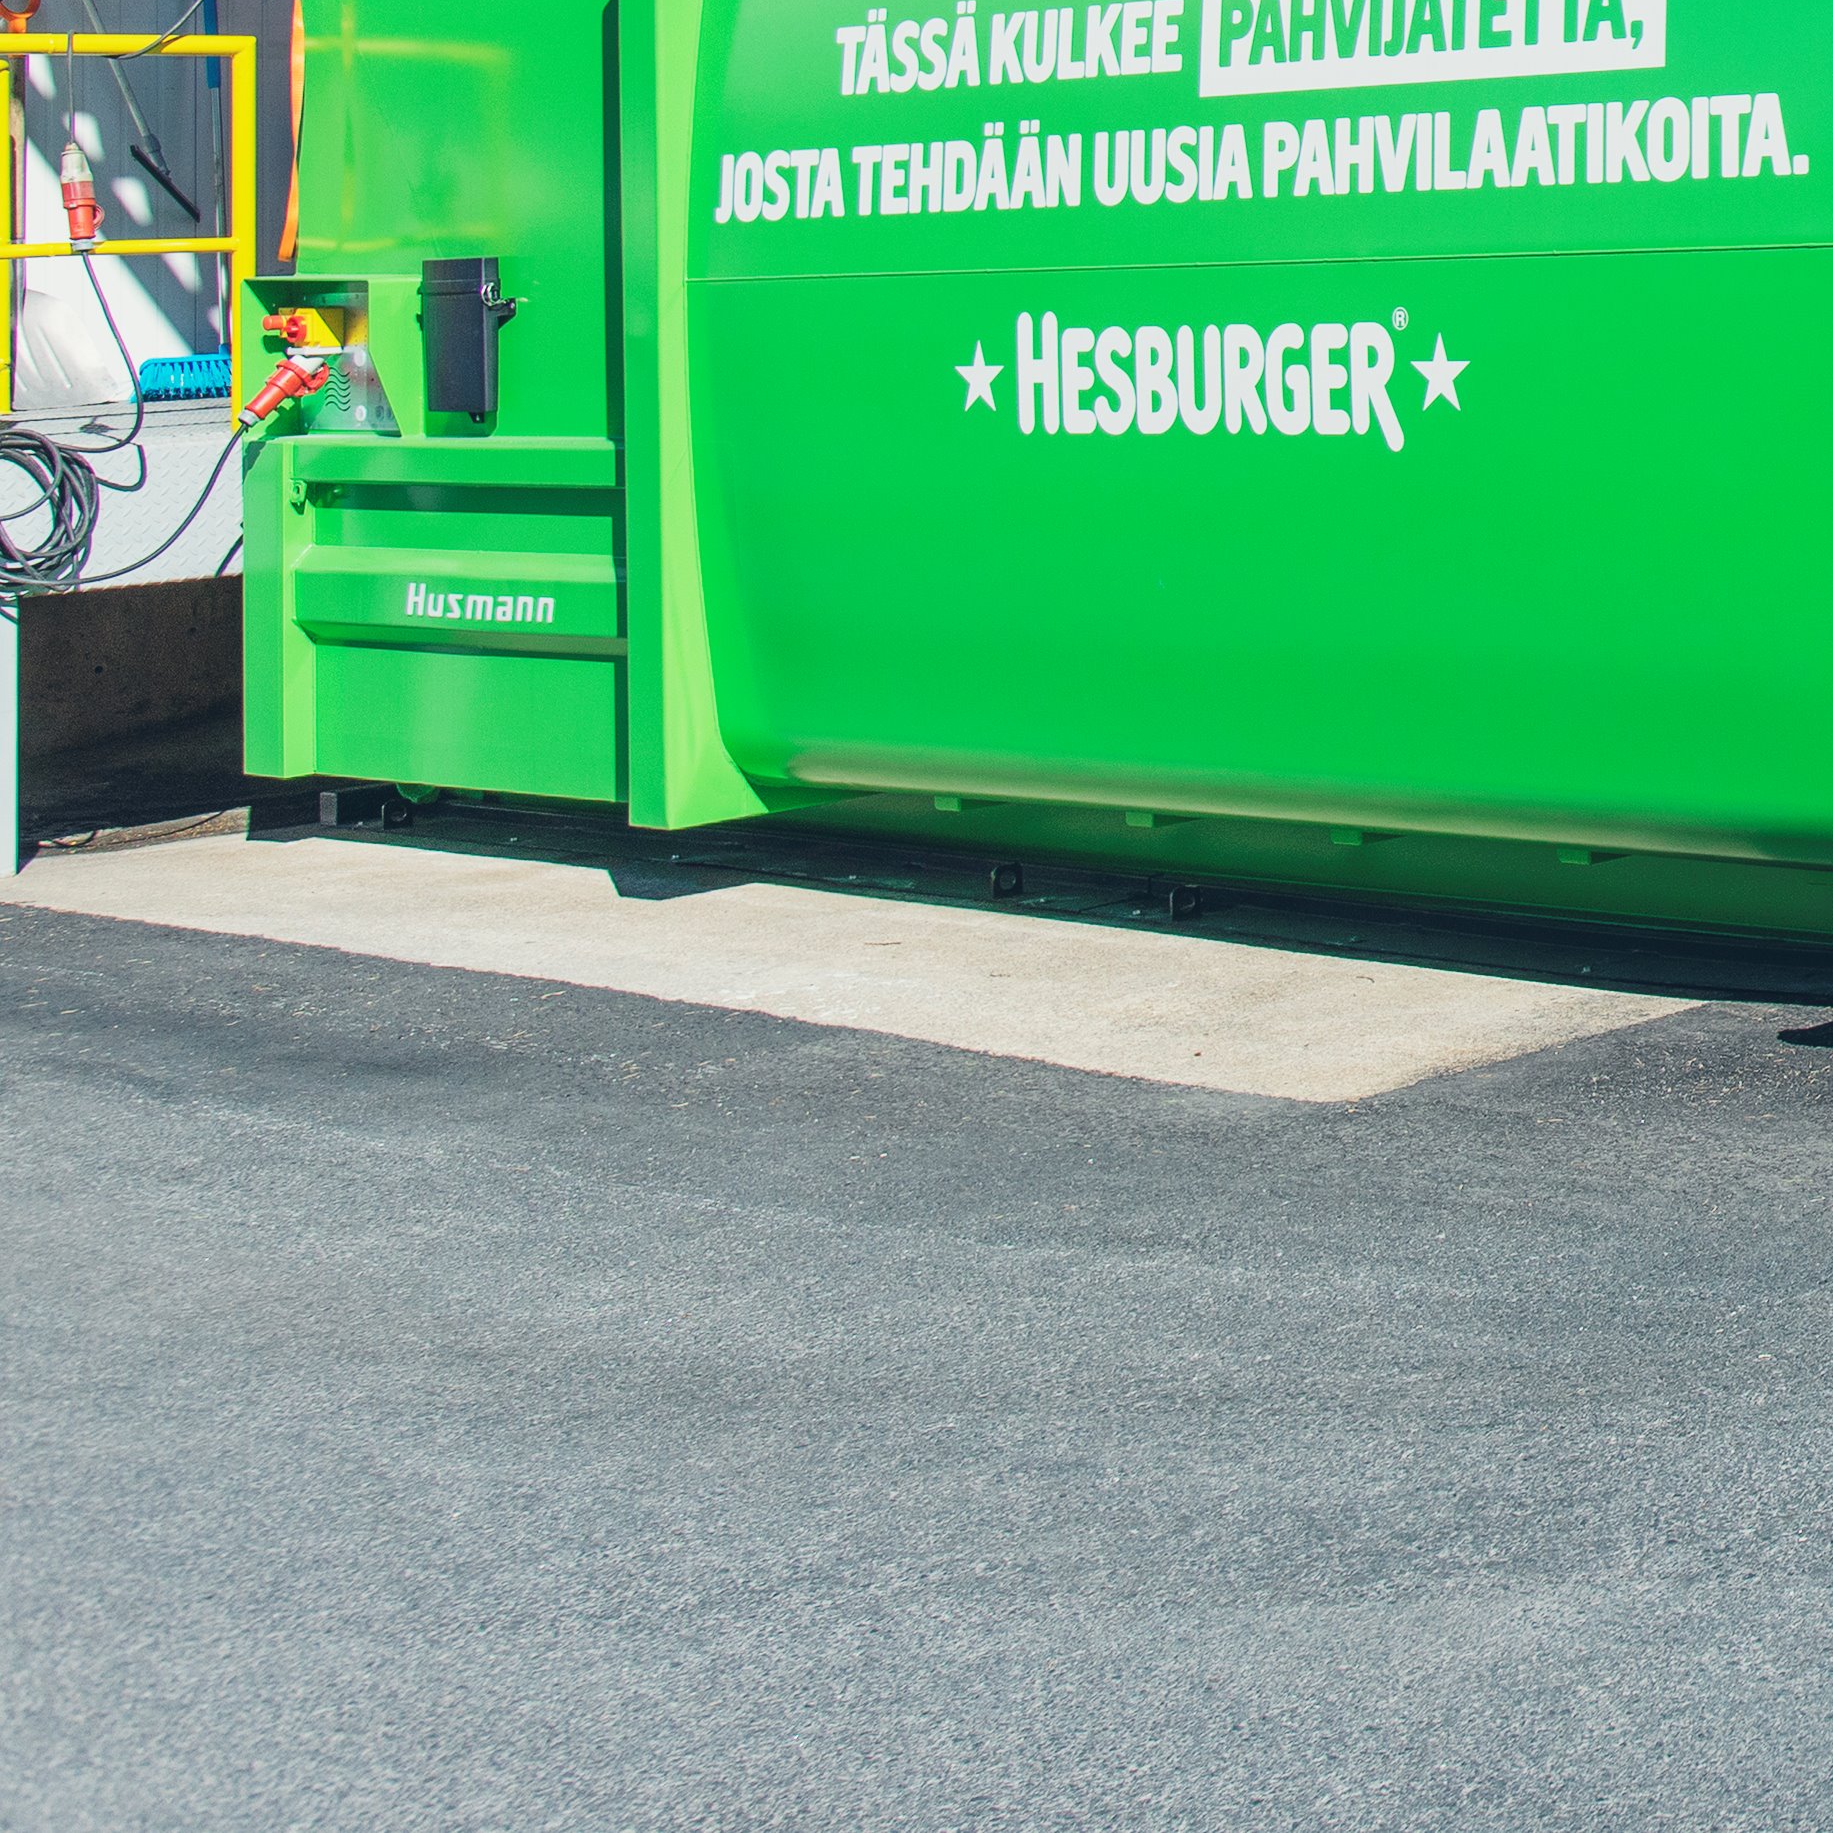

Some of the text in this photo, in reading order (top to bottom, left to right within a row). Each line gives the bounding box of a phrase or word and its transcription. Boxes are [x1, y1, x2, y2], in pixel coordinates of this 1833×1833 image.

[835, 0, 981, 96] TÄSSÄ
[714, 92, 1810, 225] JOSTA TEHDÄÄN UUSIA PAHVILAATIKOITA.
[1016, 310, 1402, 454] HESBURGER
[405, 582, 555, 624] Husmann
